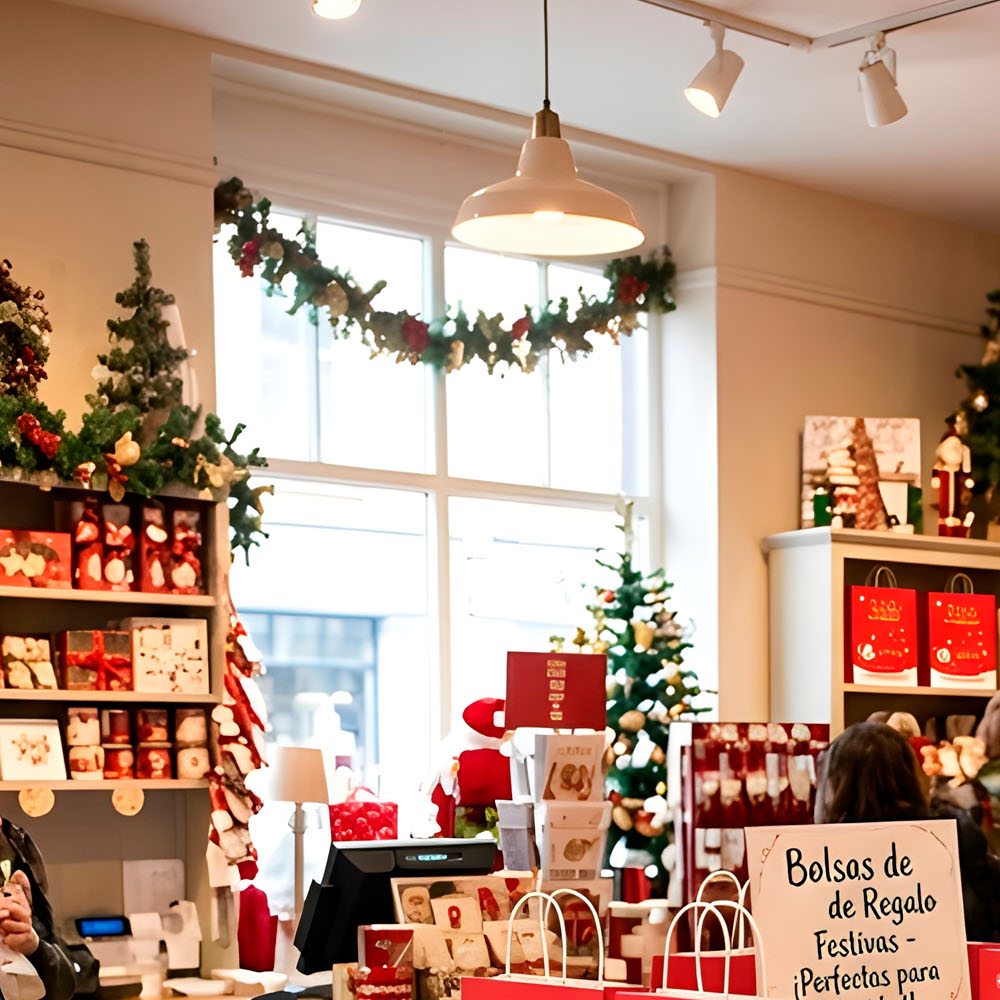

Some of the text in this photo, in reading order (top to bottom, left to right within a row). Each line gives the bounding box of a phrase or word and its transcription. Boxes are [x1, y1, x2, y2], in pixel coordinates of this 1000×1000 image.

[786, 842, 913, 887] Bolsas de
[828, 882, 937, 925] de Regalo
[814, 930, 899, 960] Festivas
[897, 965, 940, 995] para
